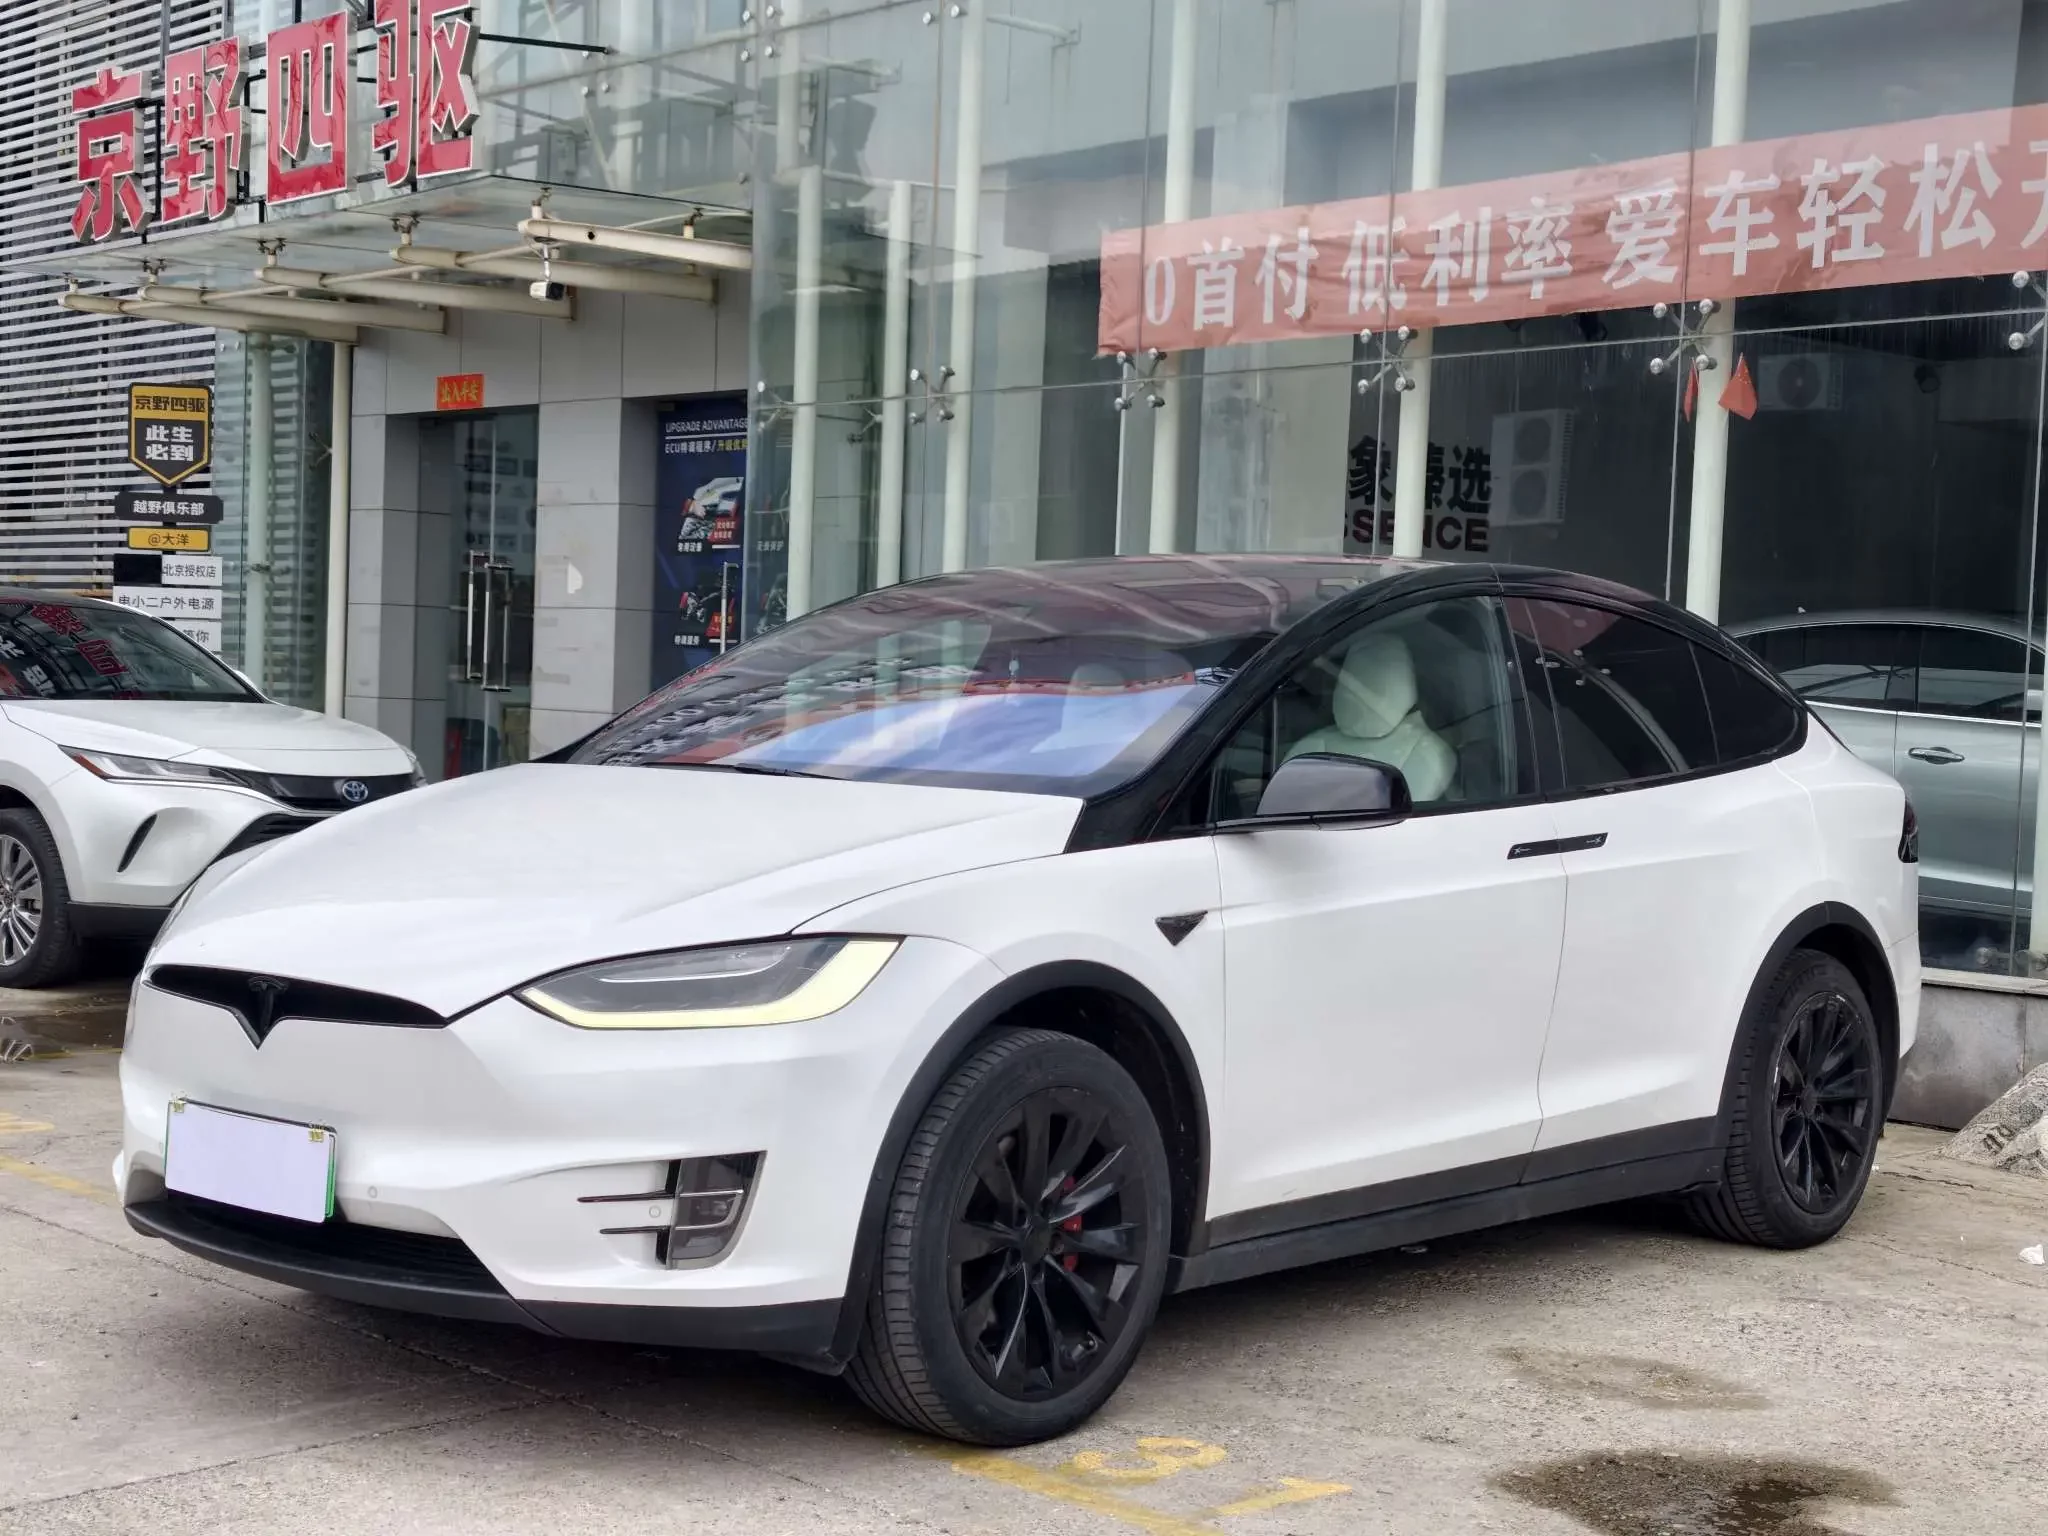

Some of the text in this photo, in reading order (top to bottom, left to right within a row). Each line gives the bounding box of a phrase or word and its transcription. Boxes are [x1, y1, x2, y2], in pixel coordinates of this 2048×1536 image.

[70, 0, 478, 242] 京野四驱
[1145, 226, 1320, 332] 0首付
[1340, 197, 1576, 316] 低利率
[135, 395, 206, 413] 京野四驱
[145, 424, 194, 442] 此生
[665, 421, 701, 433] UPGRADE
[145, 443, 194, 462] 必到
[133, 499, 205, 516] 越野俱乐部
[147, 532, 190, 547] @大洋
[162, 563, 217, 578] 北京授权店
